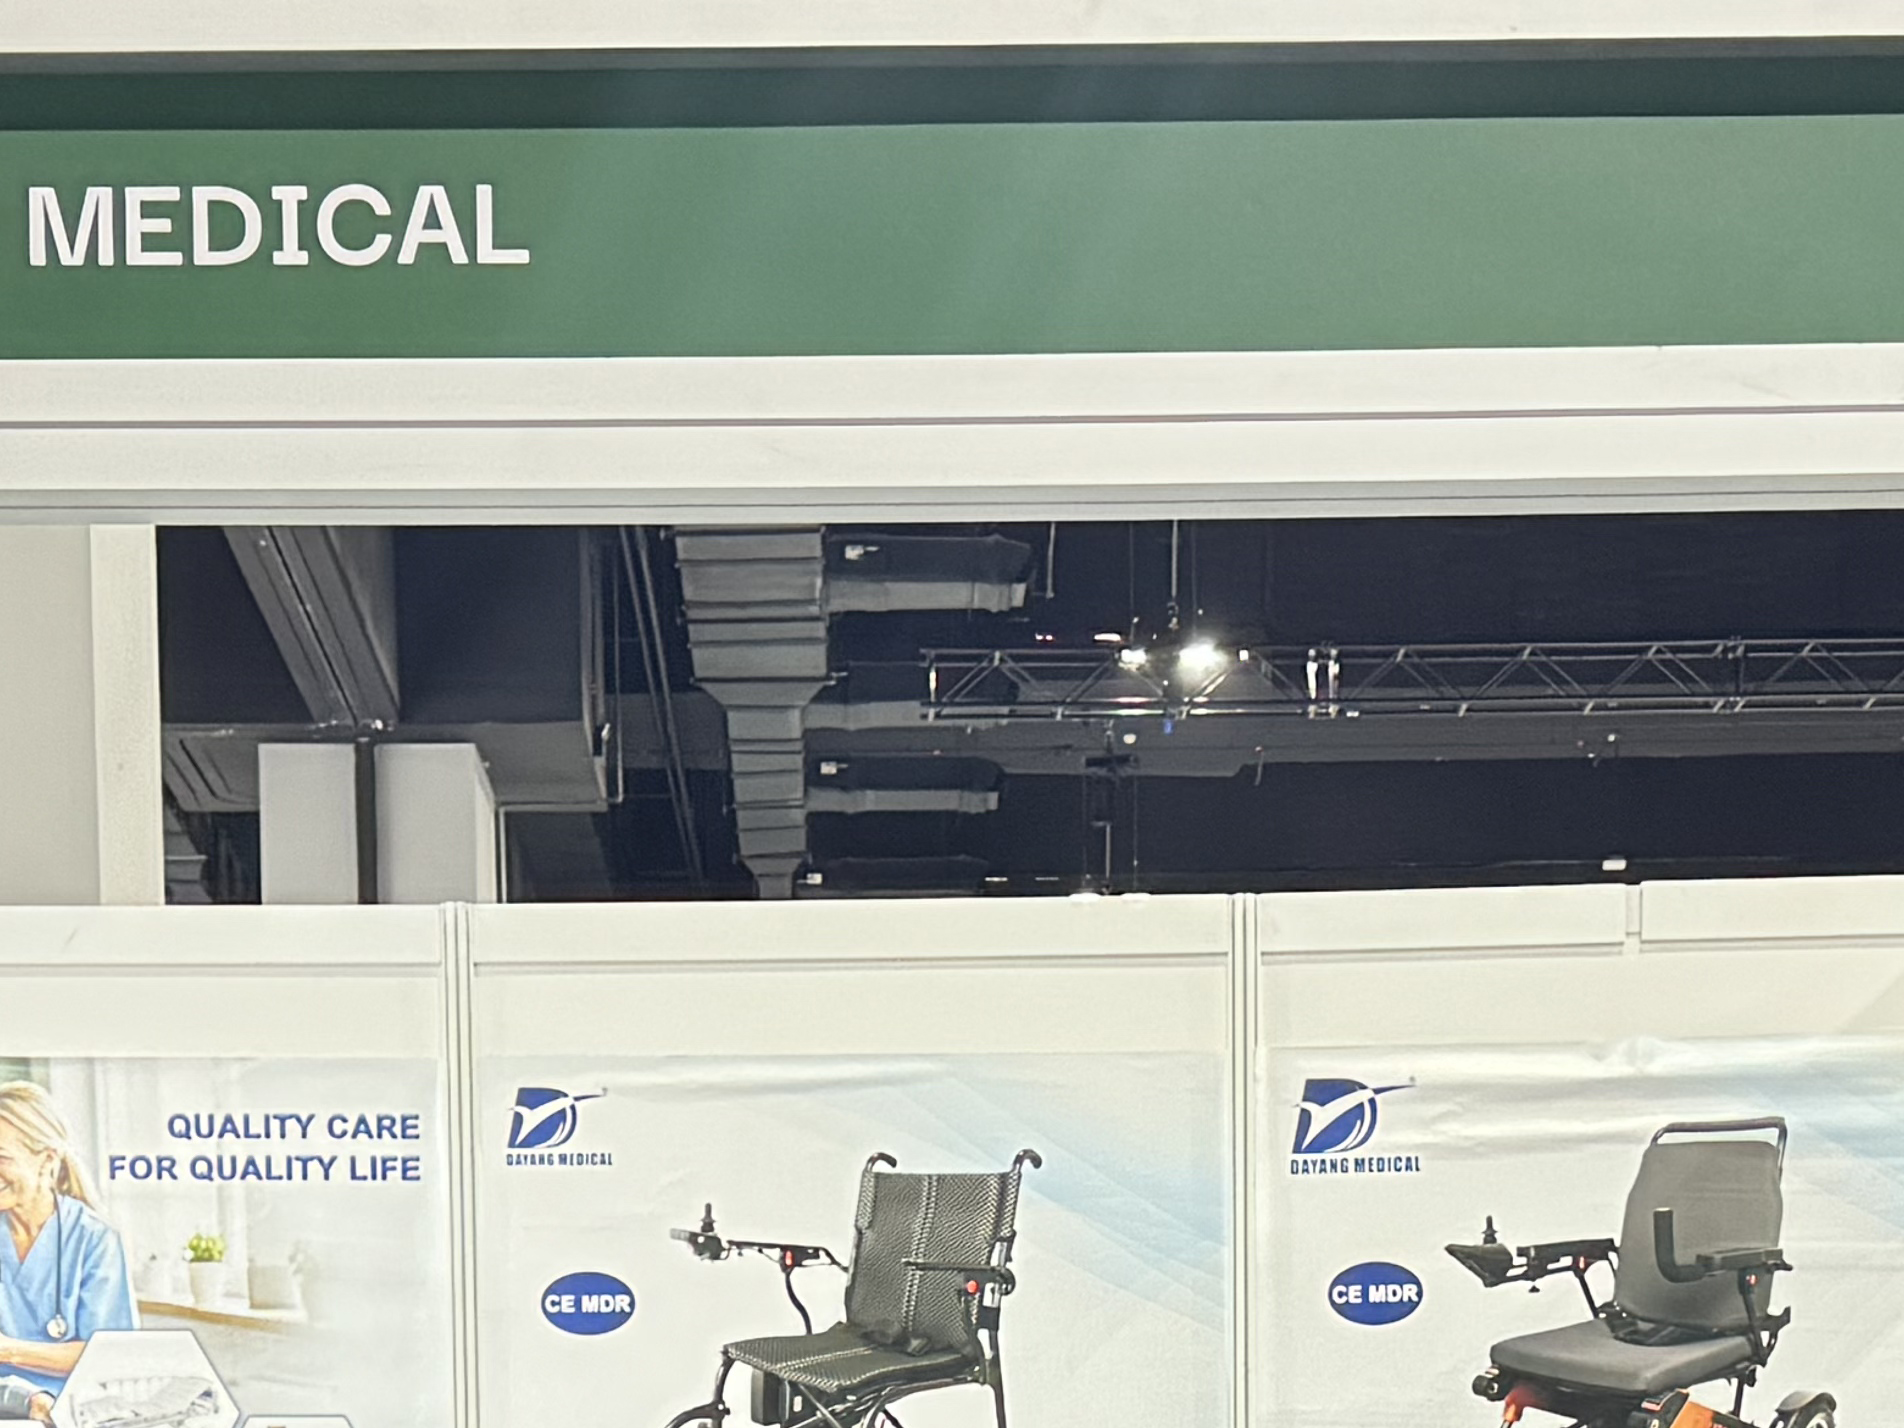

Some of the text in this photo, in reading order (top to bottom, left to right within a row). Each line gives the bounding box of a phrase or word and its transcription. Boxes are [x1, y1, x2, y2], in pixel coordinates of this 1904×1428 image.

[28, 184, 530, 267] MEDICAL
[167, 1113, 421, 1140] QUALITY CARE
[108, 1154, 422, 1182] FOR QUALITY LIFE
[506, 1152, 613, 1166] DAYANG MEDICAL
[1291, 1156, 1421, 1175] DAYANG MEDICAL
[544, 1294, 632, 1314] CE MDR
[1332, 1283, 1419, 1304] CE MDR
